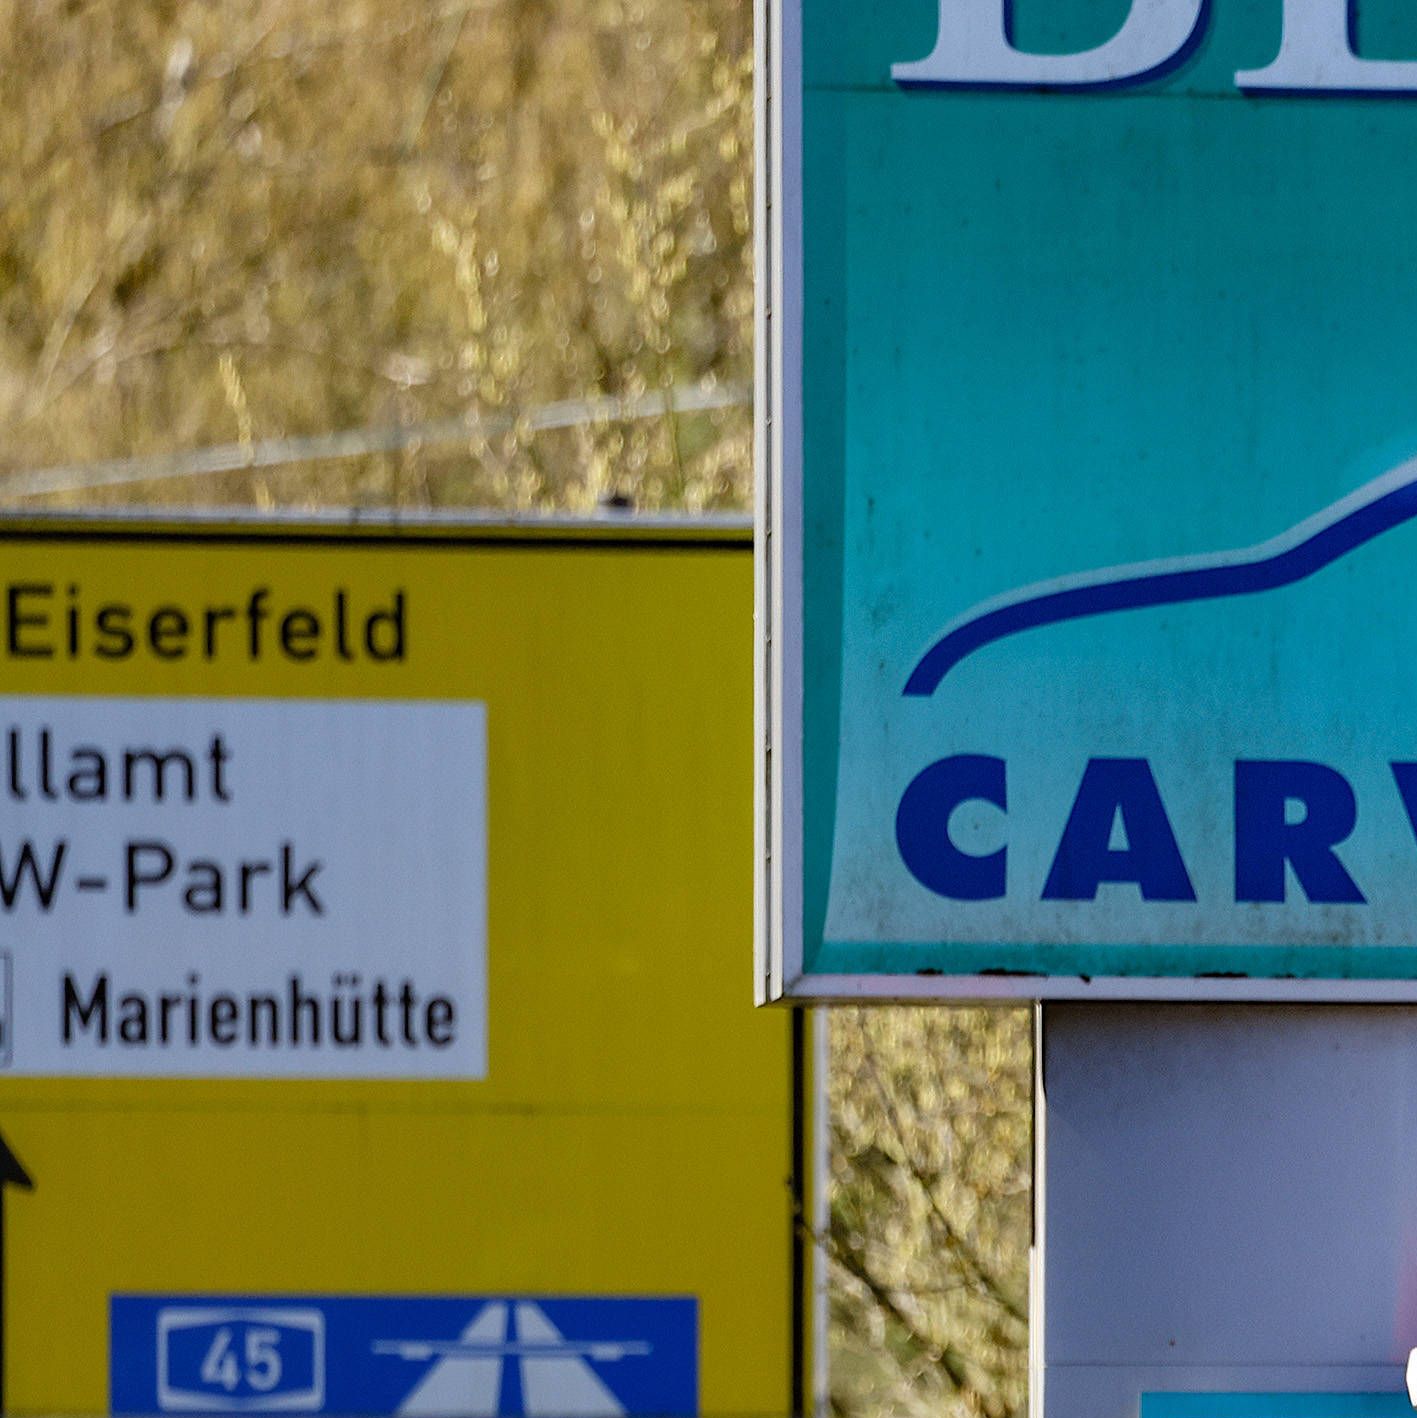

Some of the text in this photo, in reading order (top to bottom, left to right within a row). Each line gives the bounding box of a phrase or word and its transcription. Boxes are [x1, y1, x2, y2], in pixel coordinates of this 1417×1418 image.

[5, 584, 408, 662] Eiserfeld
[6, 727, 233, 802] llamt
[60, 969, 457, 1050] Marienhütte
[200, 1327, 282, 1392] 45
